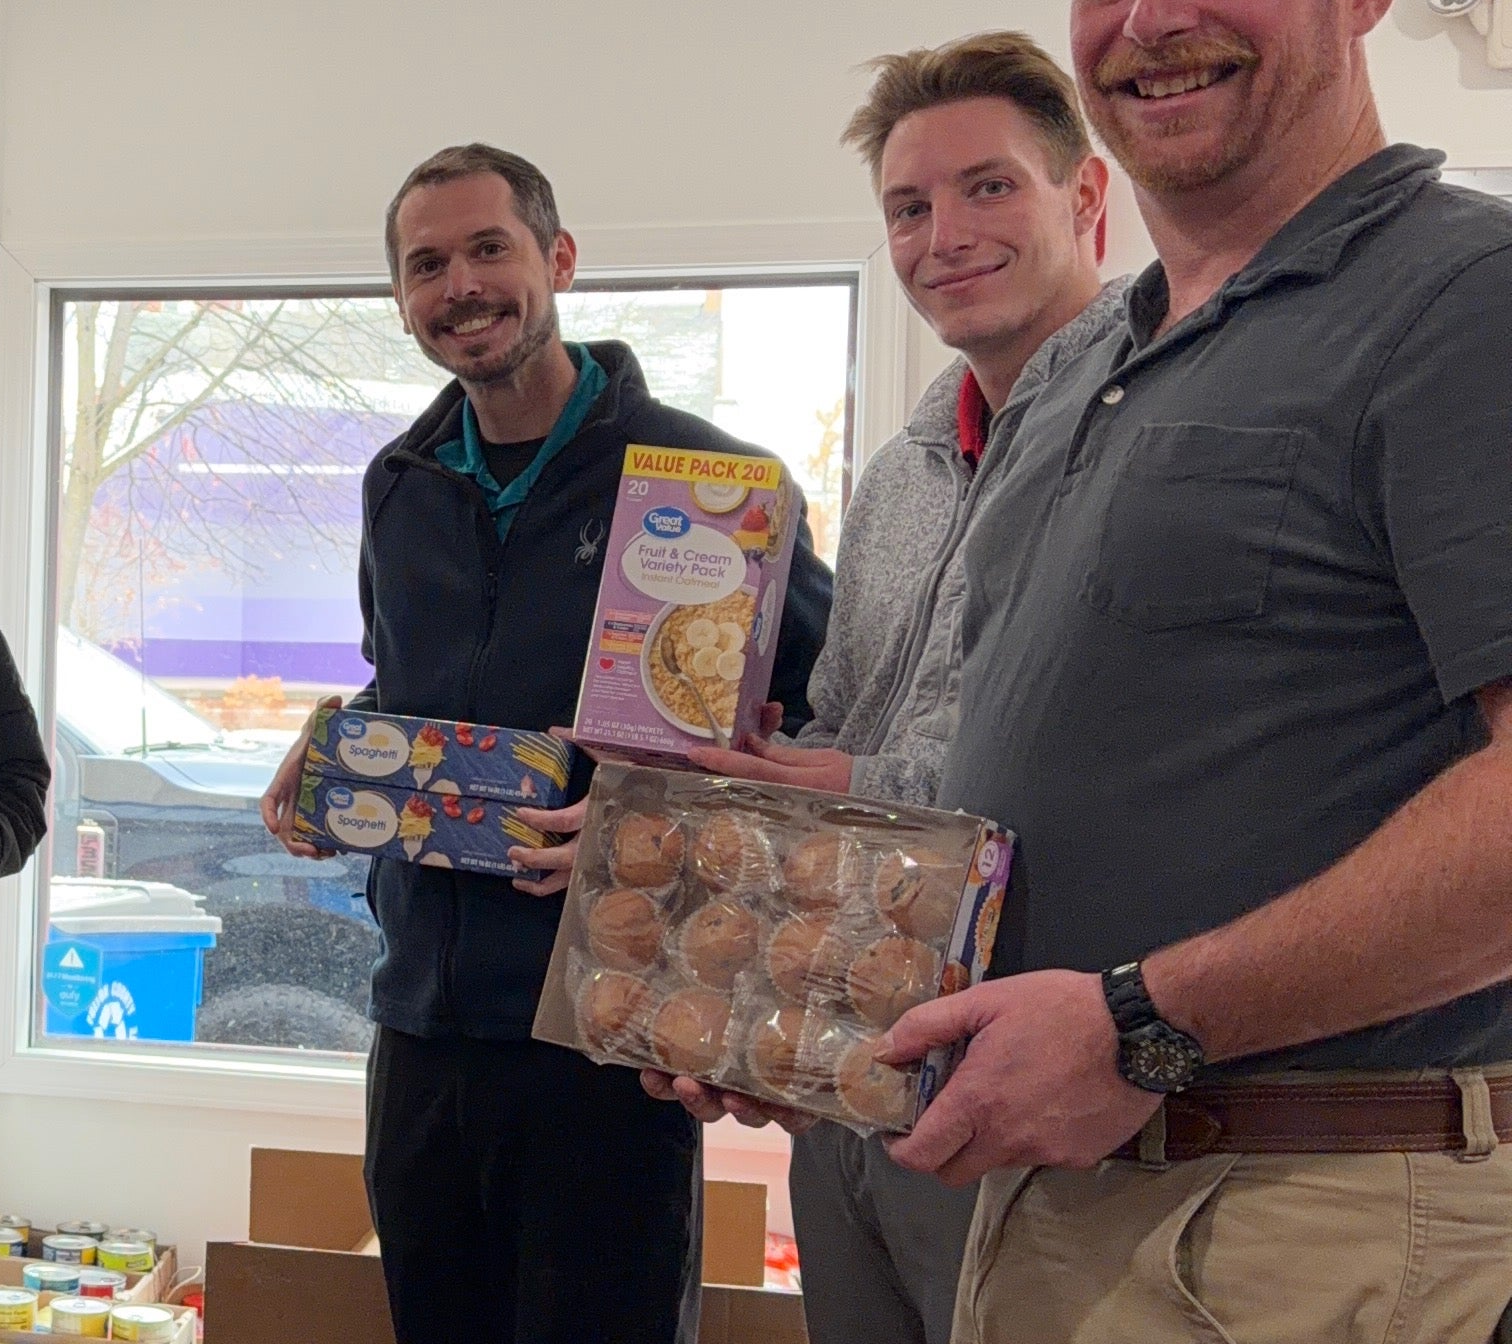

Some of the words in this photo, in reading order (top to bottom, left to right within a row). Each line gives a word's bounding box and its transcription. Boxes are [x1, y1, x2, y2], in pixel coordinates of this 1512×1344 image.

[632, 453, 684, 474] VALUE
[689, 458, 738, 480] PACK
[741, 464, 772, 484] 20!
[627, 480, 649, 496] 20
[649, 512, 683, 527] Great
[655, 523, 681, 533] Value
[638, 544, 667, 558] Fruit
[671, 549, 679, 559] &
[683, 549, 732, 566] Cream
[640, 558, 687, 575] Variety
[691, 566, 726, 578] Pack
[641, 572, 674, 585] Instant
[675, 575, 720, 590] Oatmeal
[638, 724, 664, 735] PACKETS
[349, 744, 398, 760] Spaghetti
[338, 814, 387, 831] Spaghetti
[982, 849, 995, 868] 12
